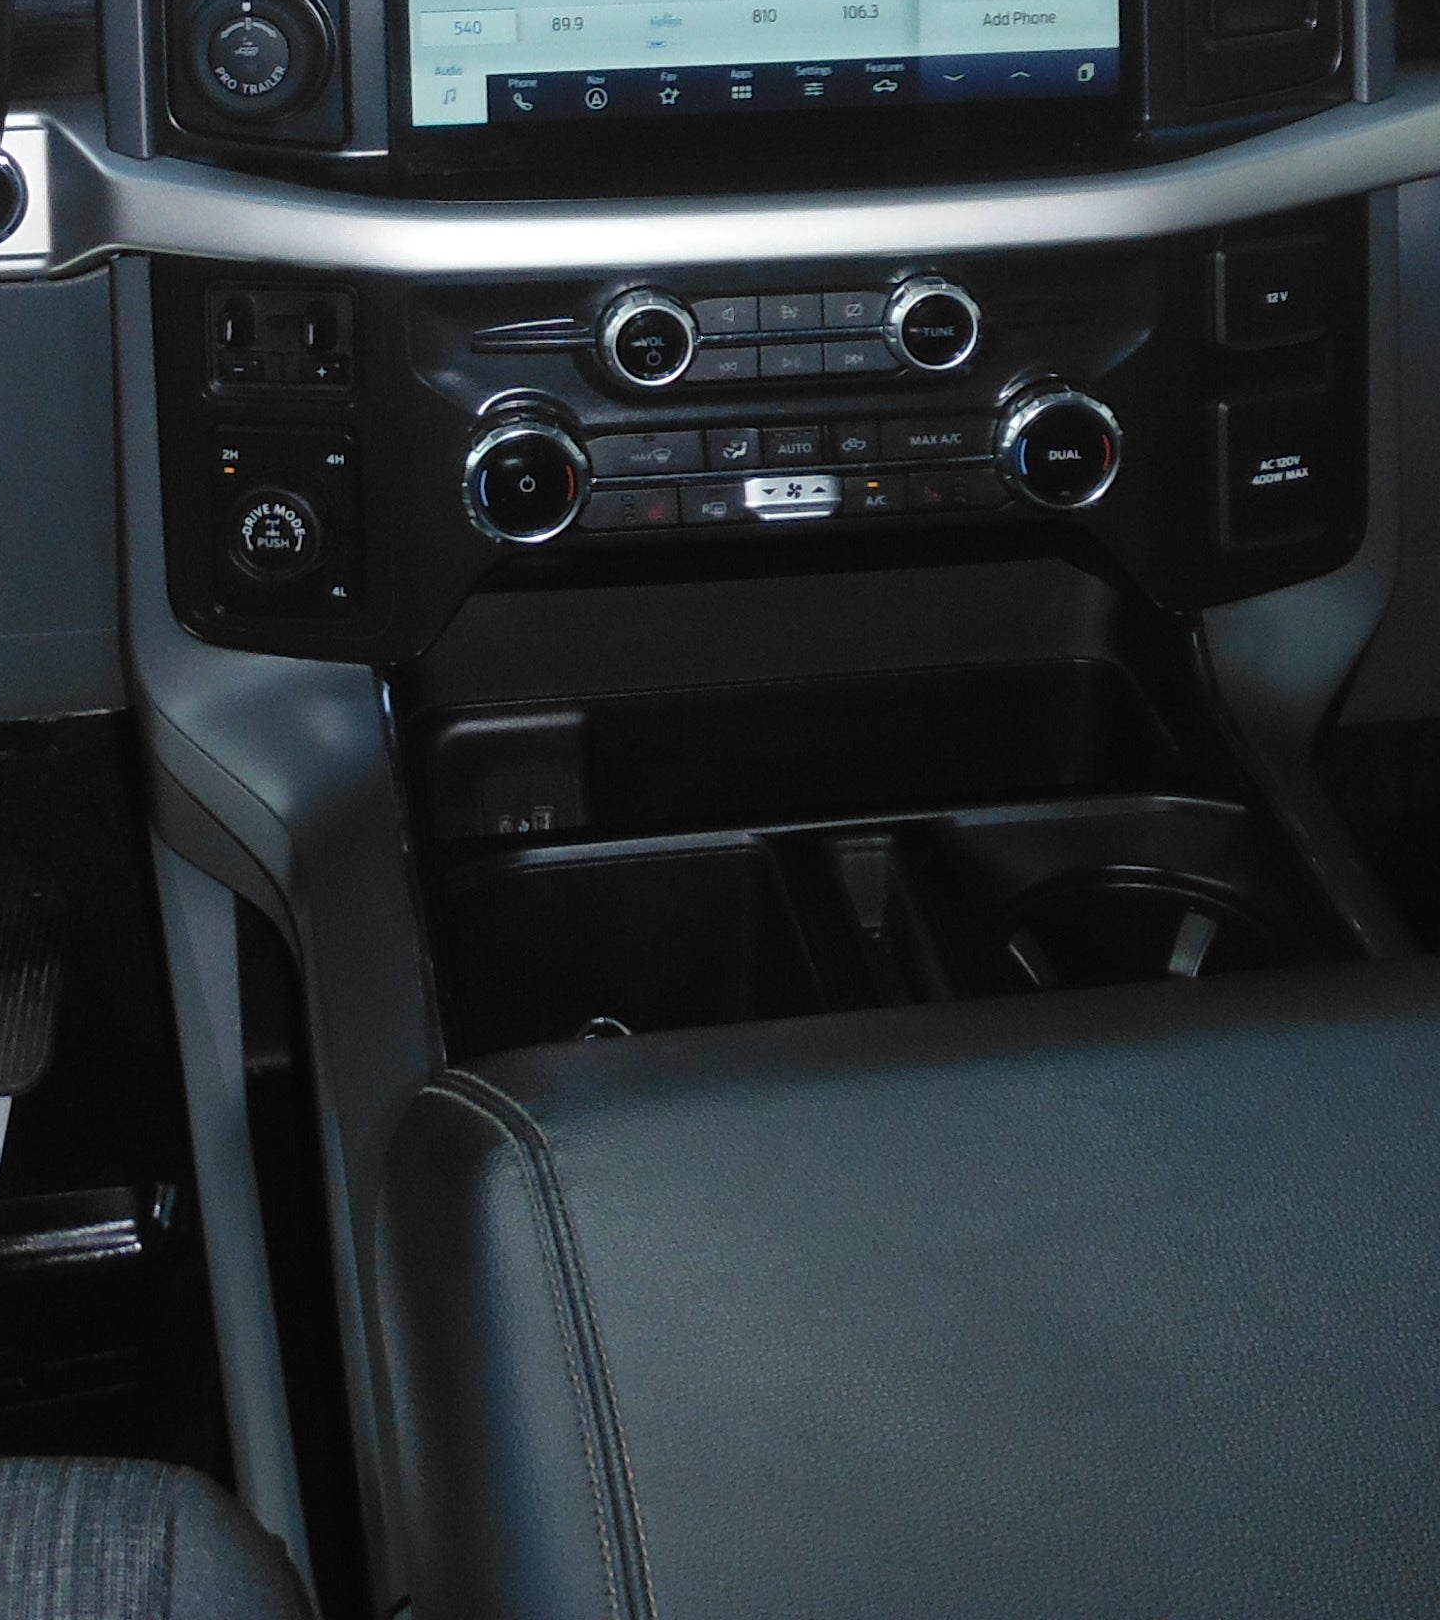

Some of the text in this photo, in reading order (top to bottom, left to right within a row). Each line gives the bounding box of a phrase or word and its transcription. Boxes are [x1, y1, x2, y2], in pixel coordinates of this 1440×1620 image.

[841, 4, 880, 20] 106.3
[551, 16, 584, 32] 89.9
[982, 11, 1057, 28] Add Phone
[453, 19, 483, 35] 540
[214, 64, 287, 96] PRO TRAILER
[922, 327, 956, 339] TUNE
[911, 433, 962, 446] MAX A/C
[221, 448, 239, 461] 2H
[777, 443, 812, 455] AUTO
[1048, 449, 1082, 462] DUAL
[326, 453, 345, 466] 4H
[1260, 455, 1301, 471] AC 120V
[1251, 467, 1310, 486] 400W MAX
[865, 494, 887, 508] A/C
[241, 502, 307, 536] DRIVE MODE
[256, 536, 290, 550] PUSH
[331, 585, 348, 598] 4L
